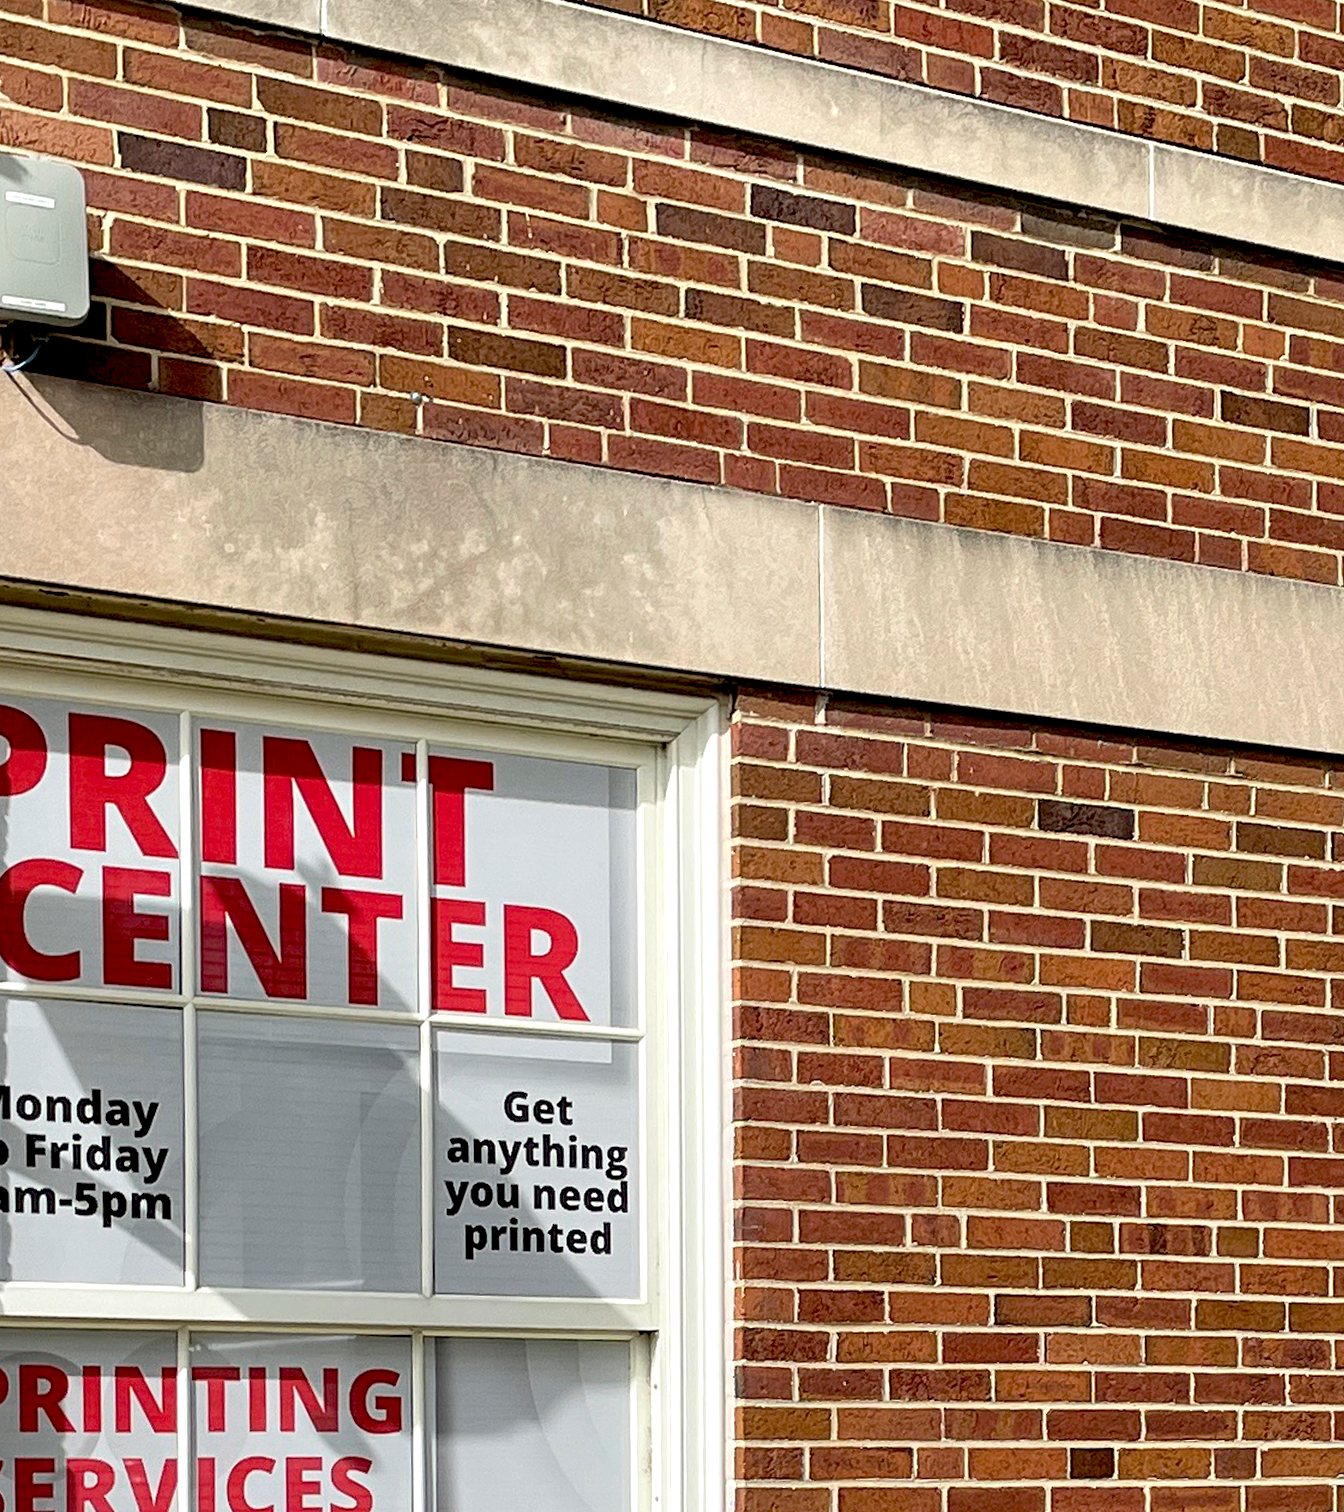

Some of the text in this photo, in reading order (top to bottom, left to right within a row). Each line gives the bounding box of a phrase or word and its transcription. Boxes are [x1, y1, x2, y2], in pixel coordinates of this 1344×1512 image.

[503, 1092, 573, 1125] Get
[24, 1133, 169, 1185] Friday
[447, 1135, 629, 1181] anything
[445, 1178, 629, 1215] you need
[464, 1221, 612, 1260] printed
